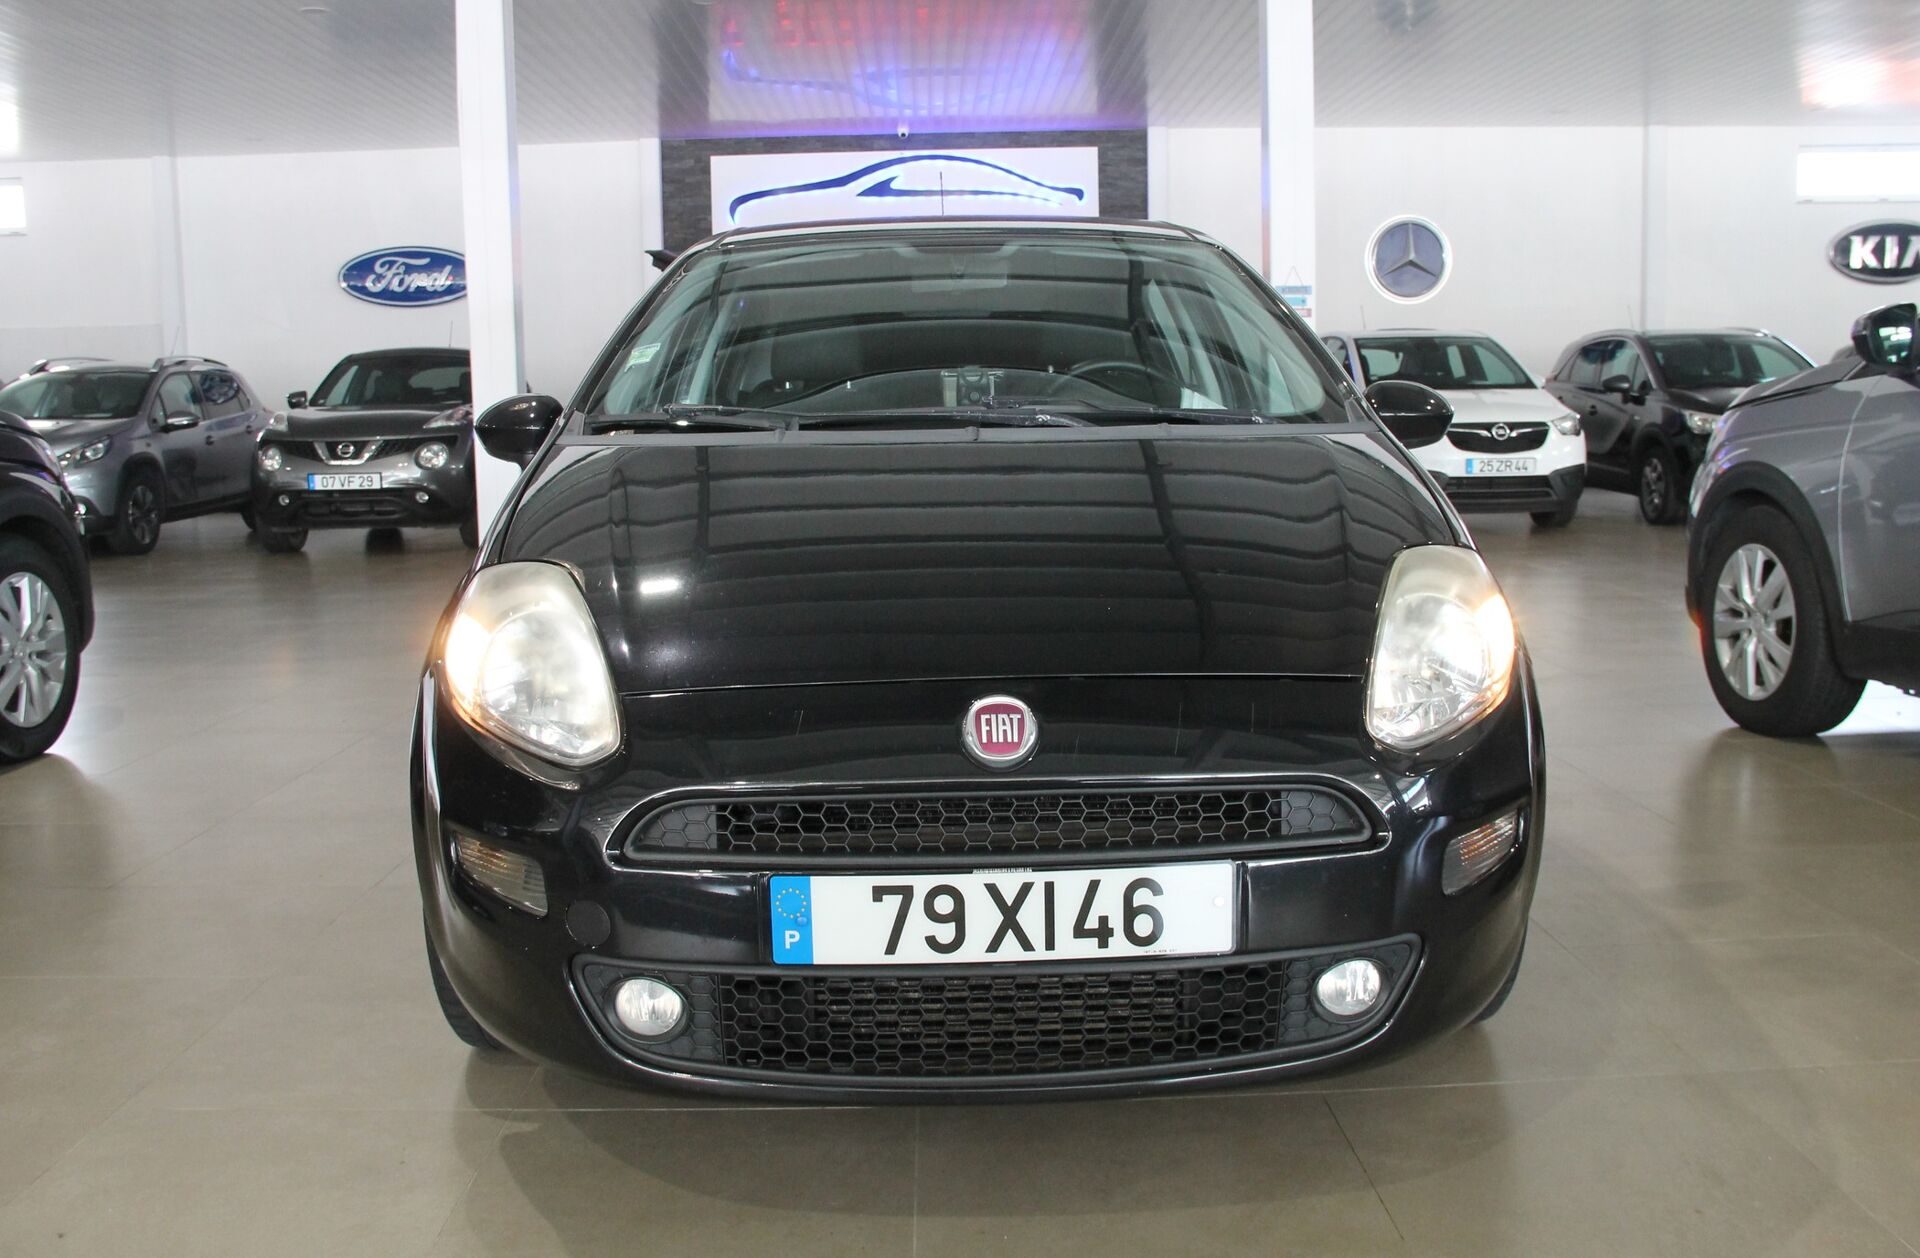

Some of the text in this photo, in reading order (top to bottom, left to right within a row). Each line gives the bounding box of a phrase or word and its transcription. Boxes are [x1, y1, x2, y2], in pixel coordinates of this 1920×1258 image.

[366, 257, 453, 293] Ford
[981, 714, 1022, 743] FIAT
[784, 930, 800, 949] P
